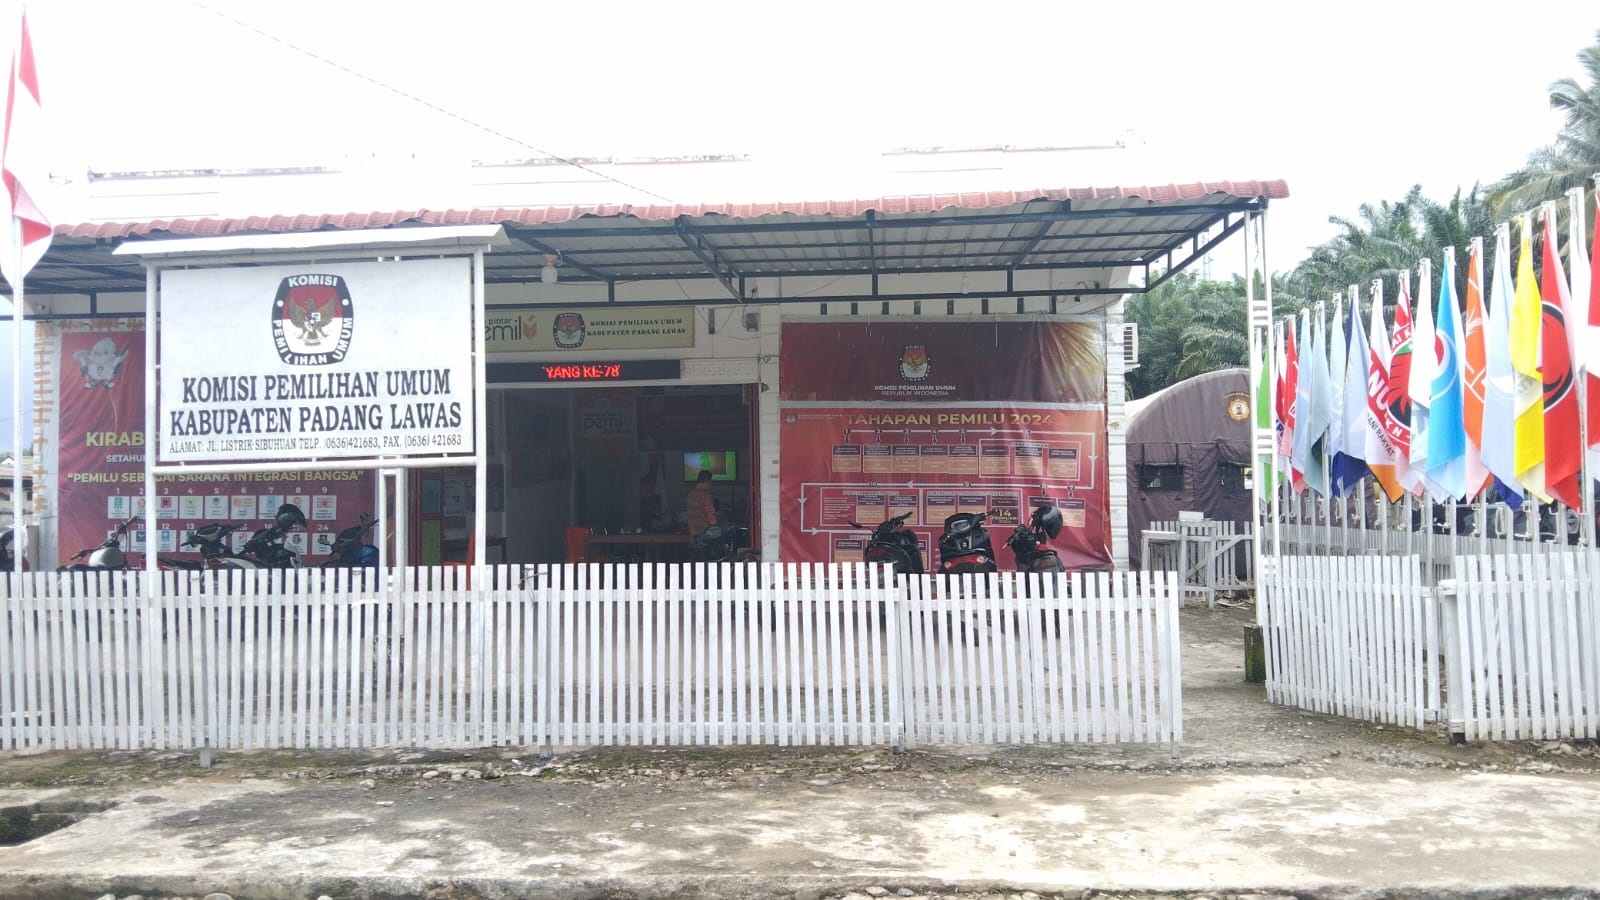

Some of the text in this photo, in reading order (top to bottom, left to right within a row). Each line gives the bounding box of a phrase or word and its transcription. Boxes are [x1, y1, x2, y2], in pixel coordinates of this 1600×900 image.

[287, 274, 339, 288] KOMISI
[488, 317, 512, 325] pintar
[272, 317, 353, 365] PEMILIHAN UMUM
[543, 363, 580, 379] YANG
[182, 368, 451, 403] KOMISI PEMILIHAN UMUM
[170, 401, 462, 437] KABUPATEN PADANG LAWAS
[847, 413, 931, 425] TAHAPAN
[937, 413, 1005, 425] PEMILU
[1010, 413, 1054, 426] 2024
[86, 431, 145, 447] KIRAB
[169, 440, 204, 453] ALAMAT:
[298, 436, 321, 449] TELP.
[383, 434, 402, 448] FAX.
[404, 434, 430, 449] (0636)
[431, 433, 462, 446] 421683
[106, 454, 146, 463] SETAHU
[178, 472, 231, 482] SARANA
[234, 471, 300, 481] INTEGRASI
[999, 509, 1012, 517] 14
